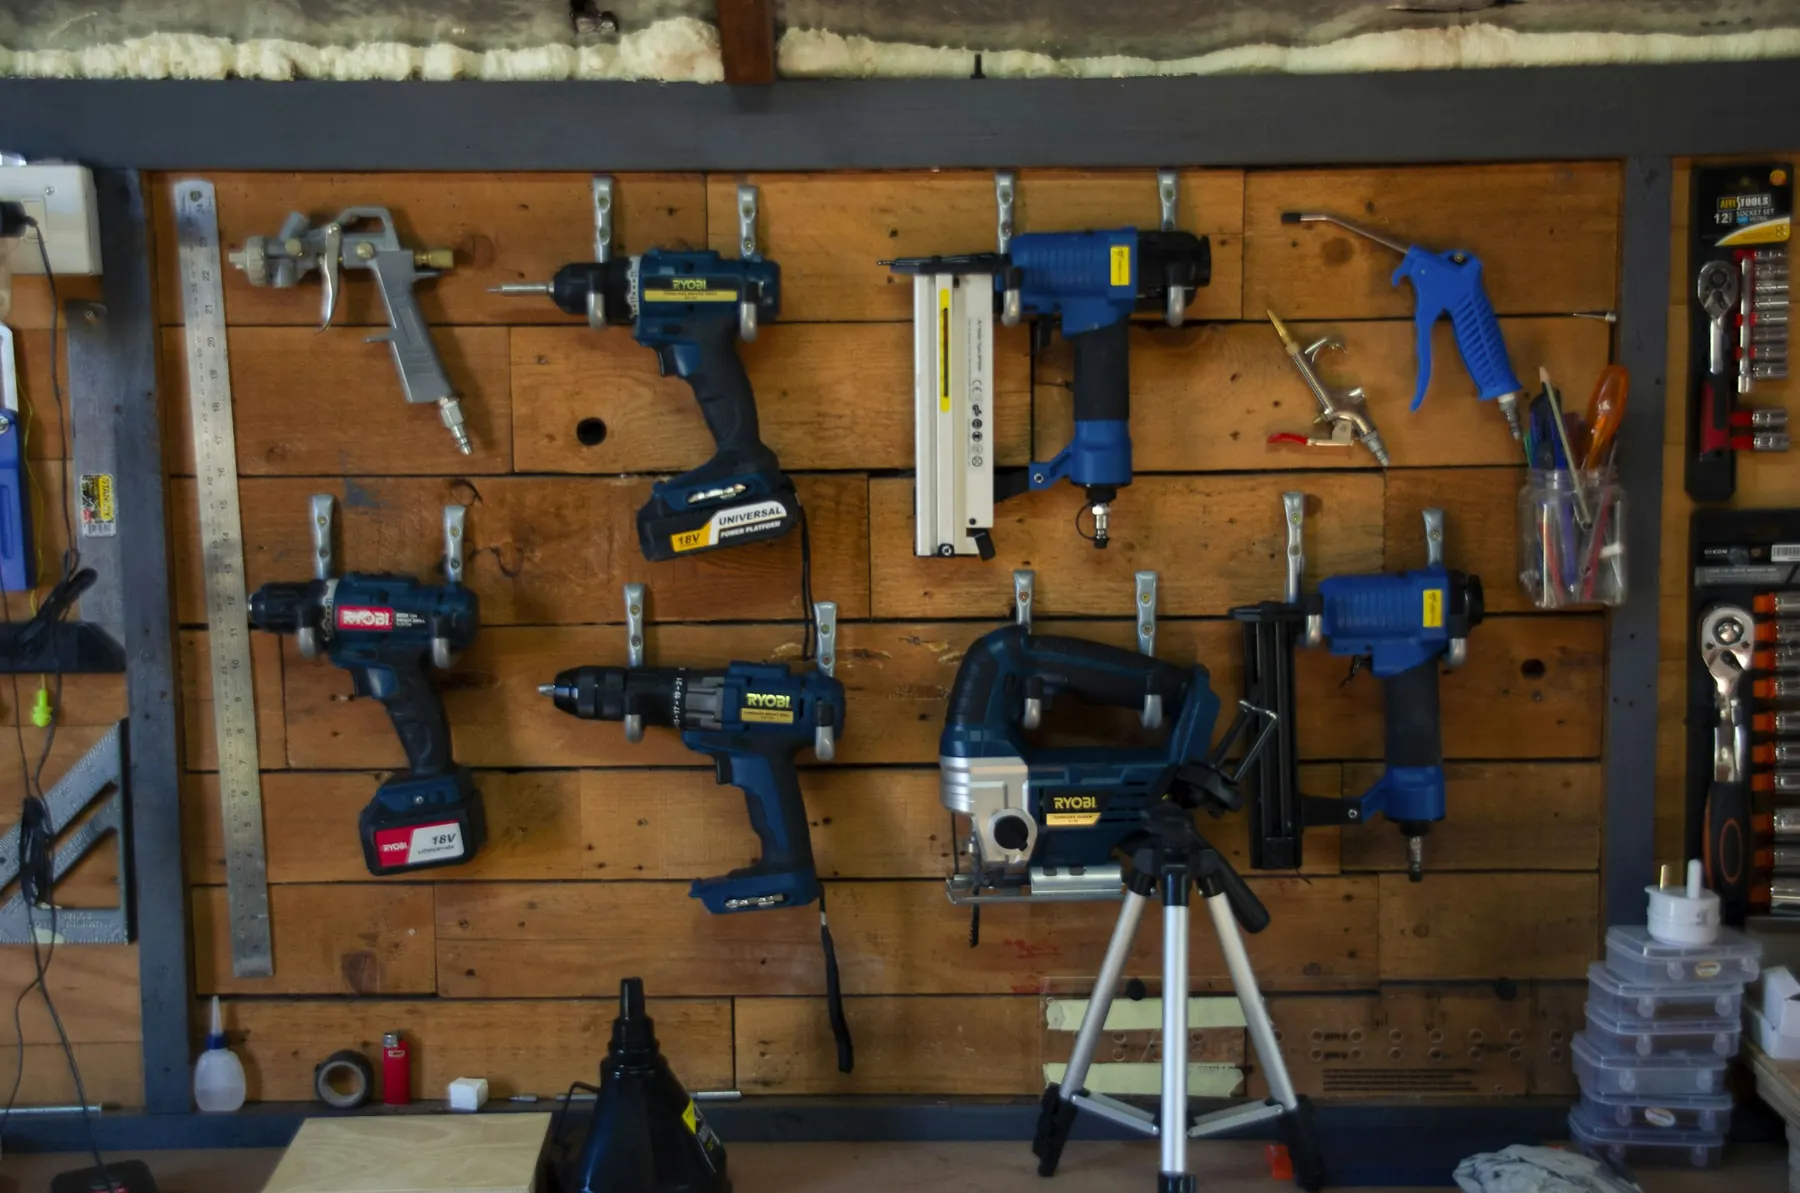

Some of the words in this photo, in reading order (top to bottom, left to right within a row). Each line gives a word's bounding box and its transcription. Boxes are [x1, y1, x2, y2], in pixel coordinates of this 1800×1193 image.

[1714, 212, 1728, 224] 12
[1736, 209, 1761, 217] SOCKET
[203, 270, 210, 282] 22
[672, 279, 707, 290] RYOBI
[205, 304, 212, 315] 21
[207, 336, 216, 348] 20
[209, 369, 218, 379] 19
[212, 402, 220, 412] 18
[719, 506, 781, 526] UNIVERSAL
[720, 527, 745, 539] POWER
[745, 520, 781, 533] PLATFORM
[678, 533, 701, 546] 18V
[342, 609, 390, 626] RYOBI
[746, 692, 791, 709] RYOBI
[1053, 796, 1096, 809] RYOBI
[431, 832, 457, 846] 18V
[382, 841, 408, 852] RYOBI
